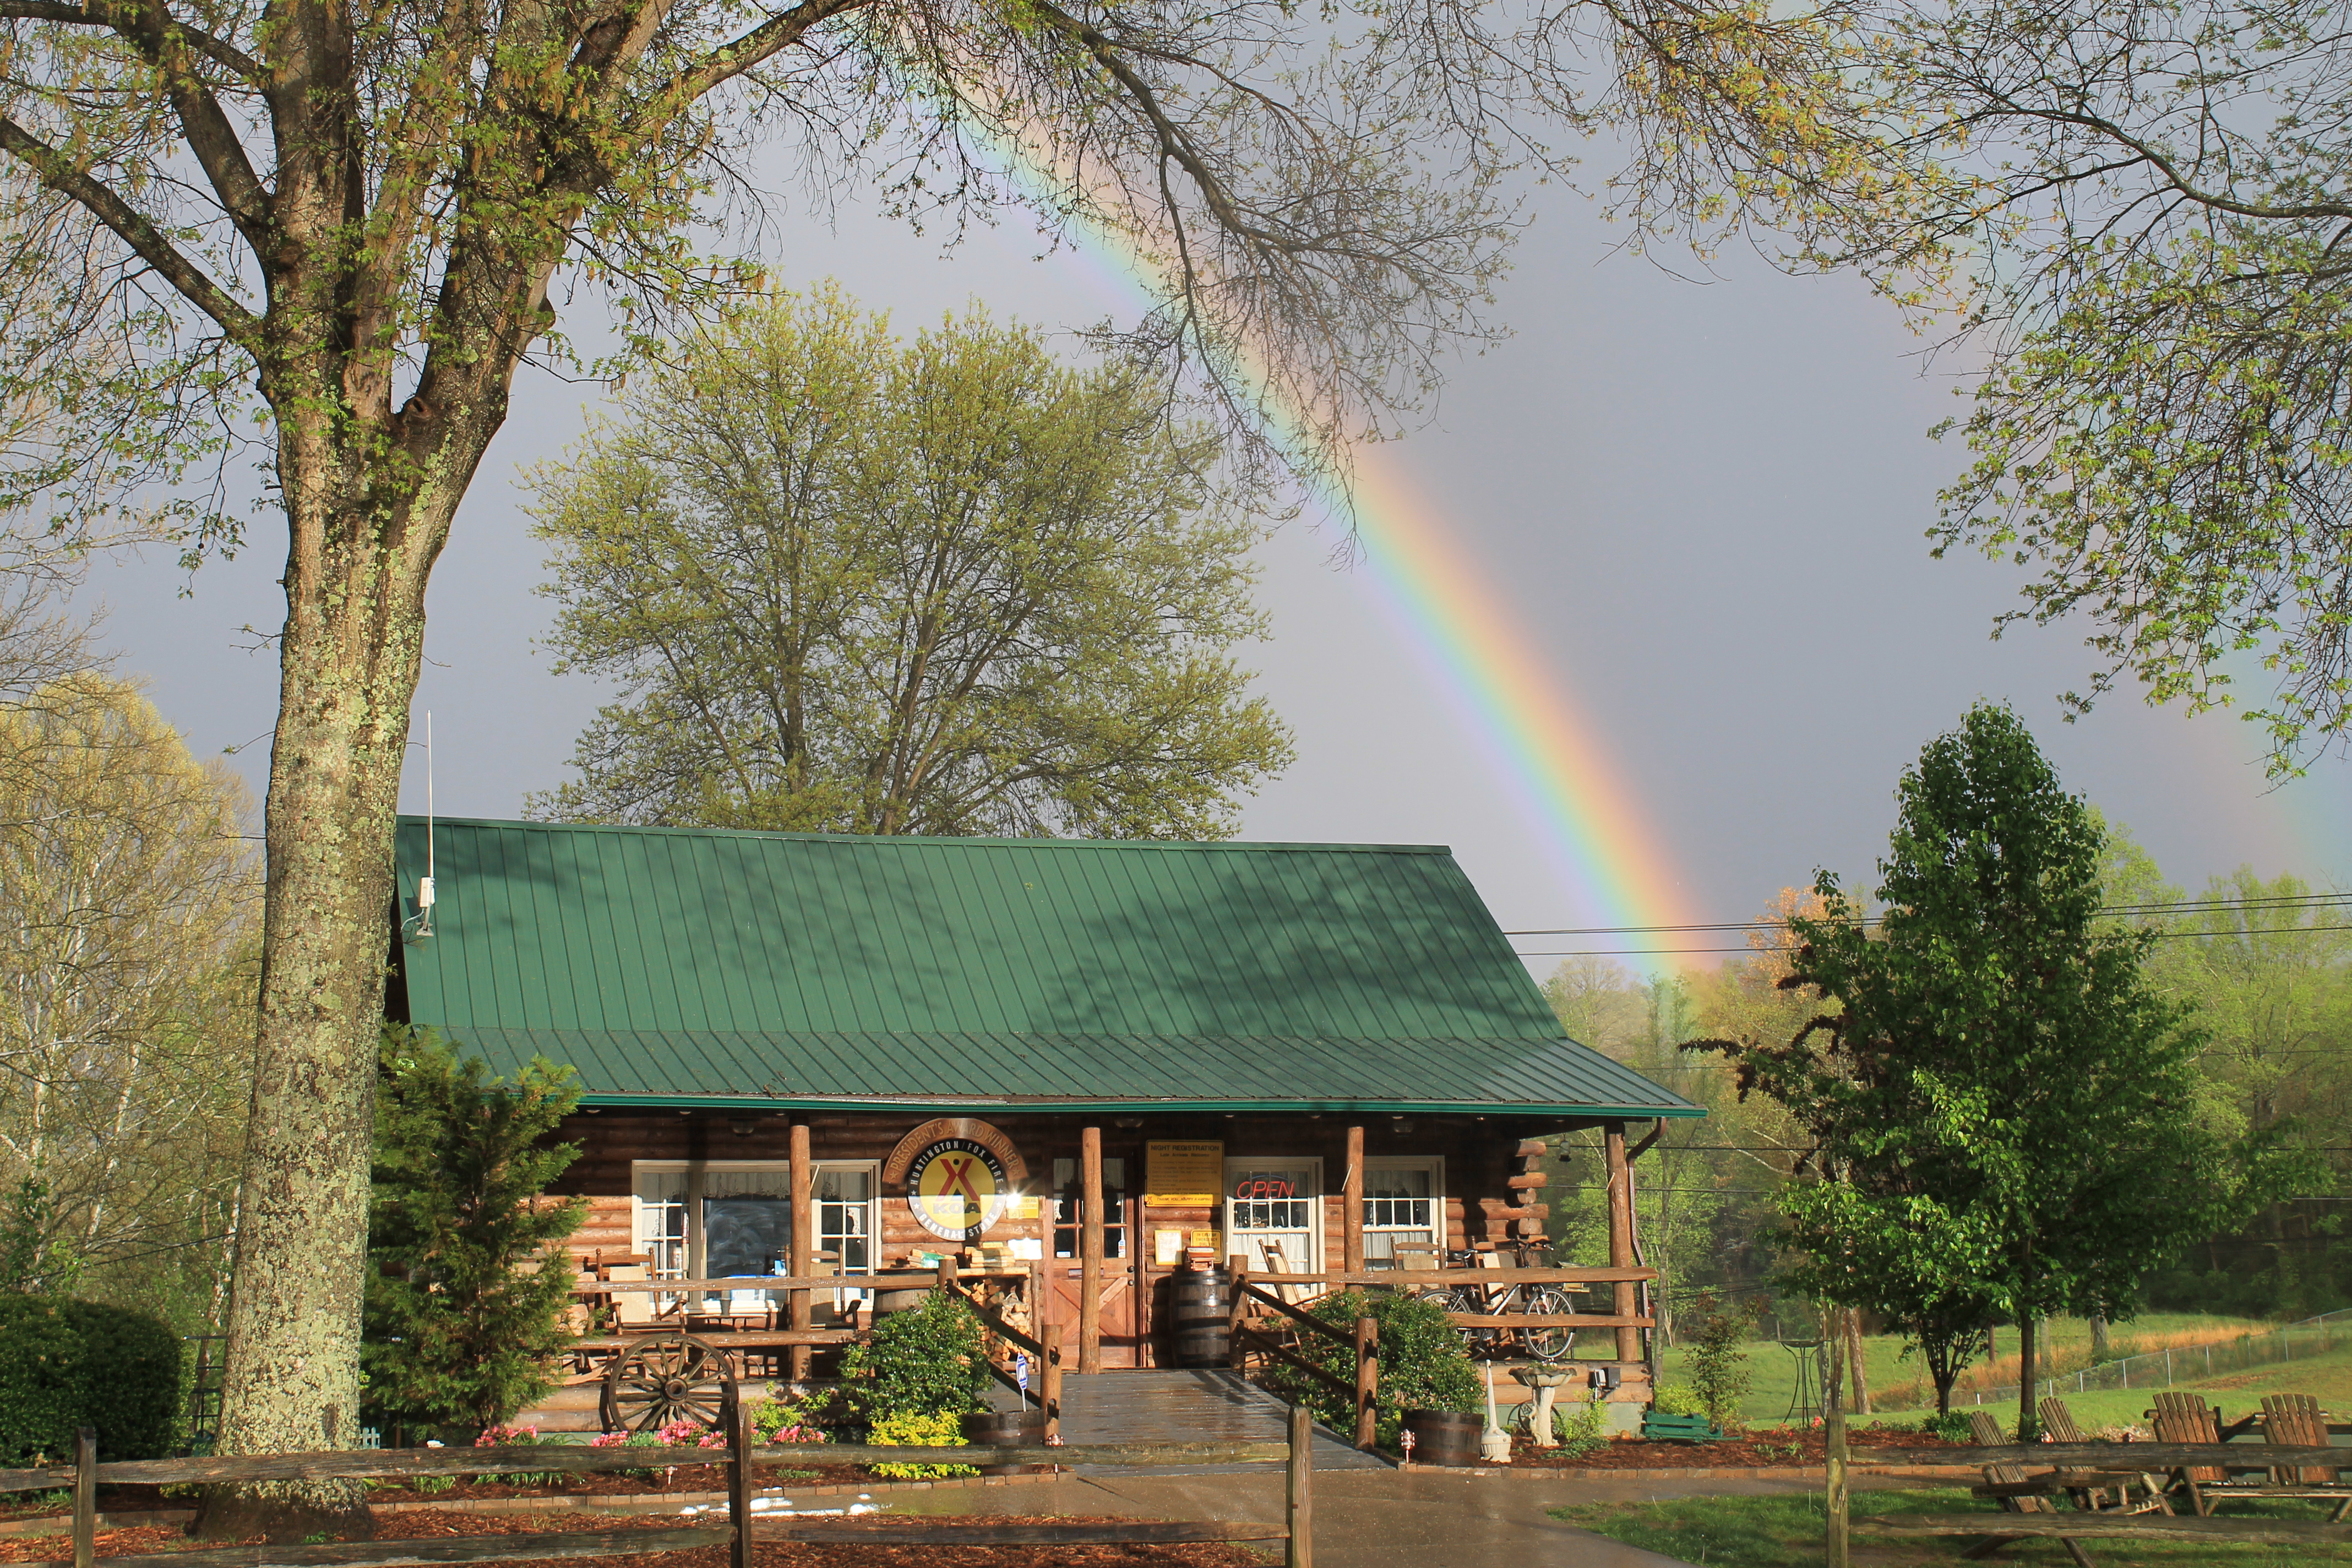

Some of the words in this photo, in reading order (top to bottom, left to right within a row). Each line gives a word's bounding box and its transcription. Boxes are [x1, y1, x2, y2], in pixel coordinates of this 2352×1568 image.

[890, 1122, 944, 1172] PRESIDENT'S
[947, 1120, 984, 1137] AWARD
[984, 1129, 1020, 1169] WINNER
[988, 1159, 1004, 1184] FIRE
[1237, 1181, 1295, 1199] OPEN
[933, 1202, 981, 1214] KOA
[919, 1213, 963, 1240] GENERAL
[968, 1212, 997, 1237] STORE
